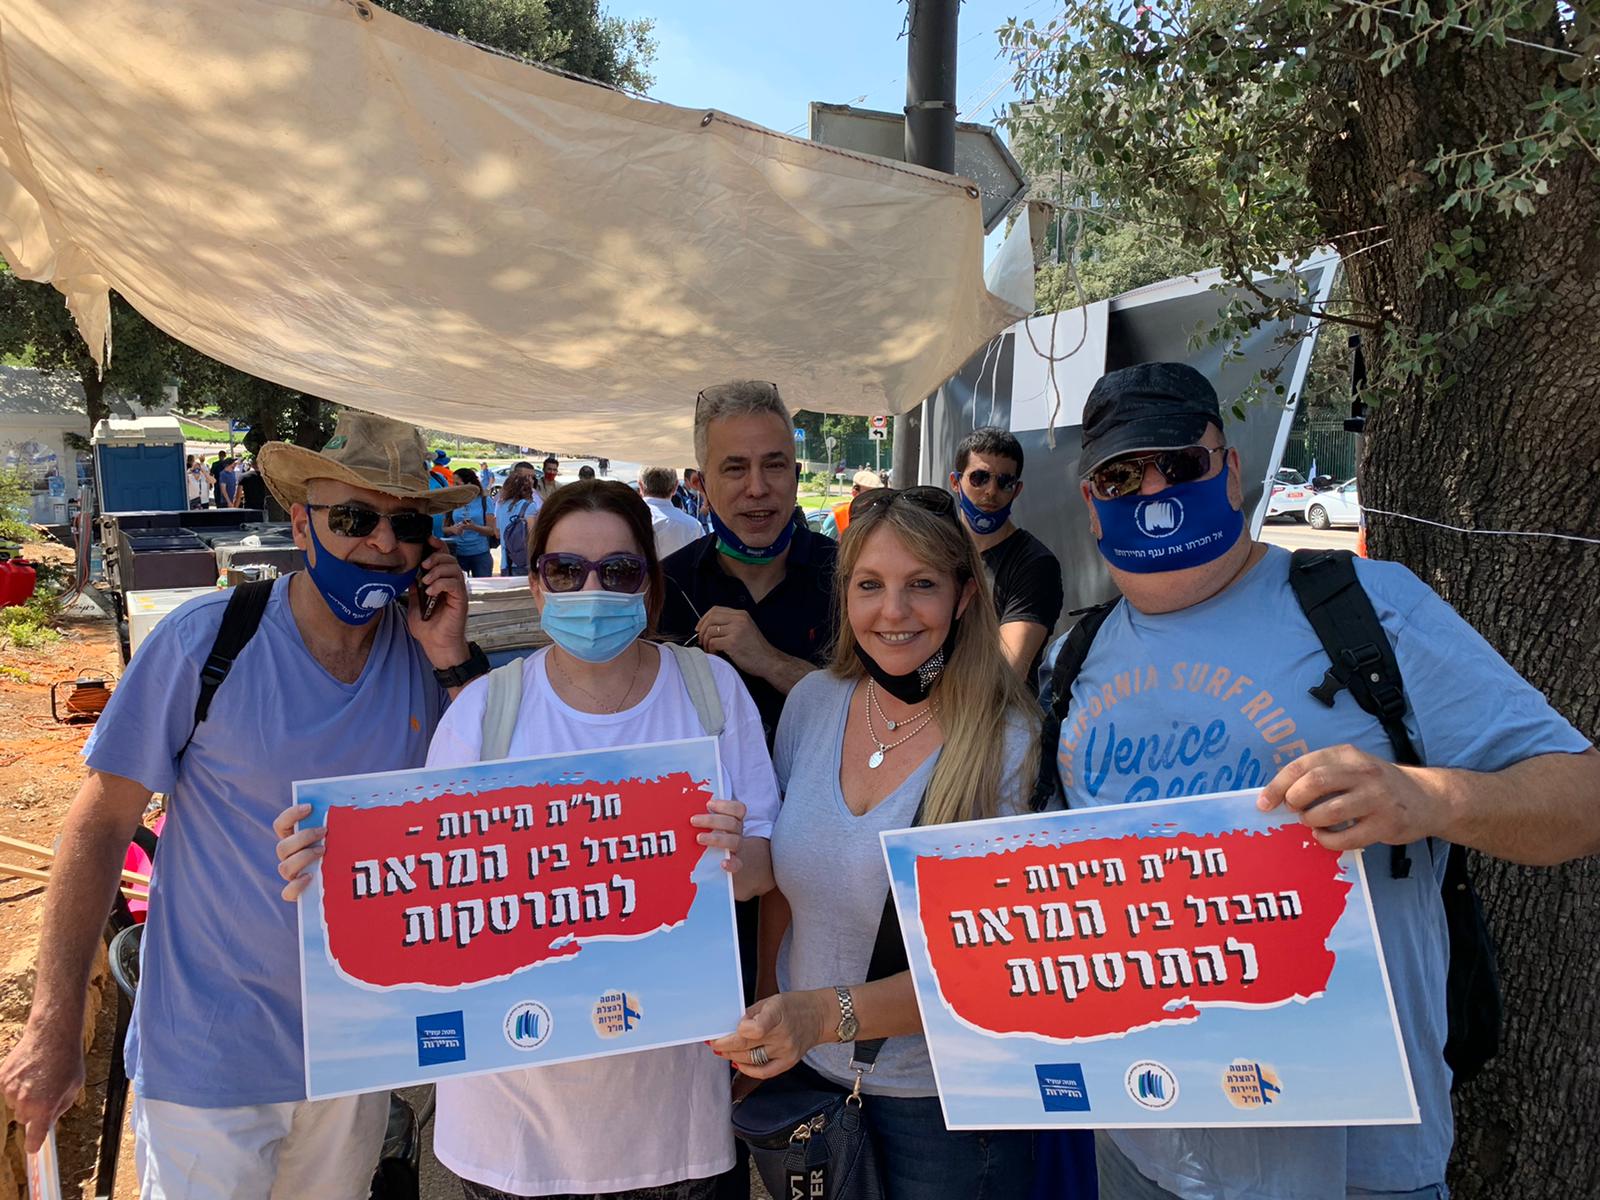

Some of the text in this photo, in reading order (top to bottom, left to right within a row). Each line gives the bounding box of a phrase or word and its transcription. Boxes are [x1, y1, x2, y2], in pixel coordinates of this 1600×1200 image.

[1168, 544, 1183, 554] את
[1168, 661, 1254, 702] SURF
[1240, 689, 1310, 772] RIDE
[1084, 718, 1231, 798] Venice
[437, 803, 534, 839] תיירות
[352, 830, 677, 900] ההבדל בין המראה
[1024, 858, 1127, 892] תיירות
[402, 875, 636, 948] להתרסקות
[950, 890, 1303, 947] ההבדל בין המראה
[1006, 937, 1259, 1002] להתרסקות
[597, 1003, 622, 1014] להצלת
[600, 994, 621, 1003] המטה
[598, 1014, 622, 1024] תיירות
[423, 1039, 460, 1048] התיירות
[1227, 1074, 1256, 1083] להצלת
[1229, 1064, 1254, 1072] המטה
[1231, 1085, 1259, 1093] תיירות
[810, 1169, 823, 1200] ER
